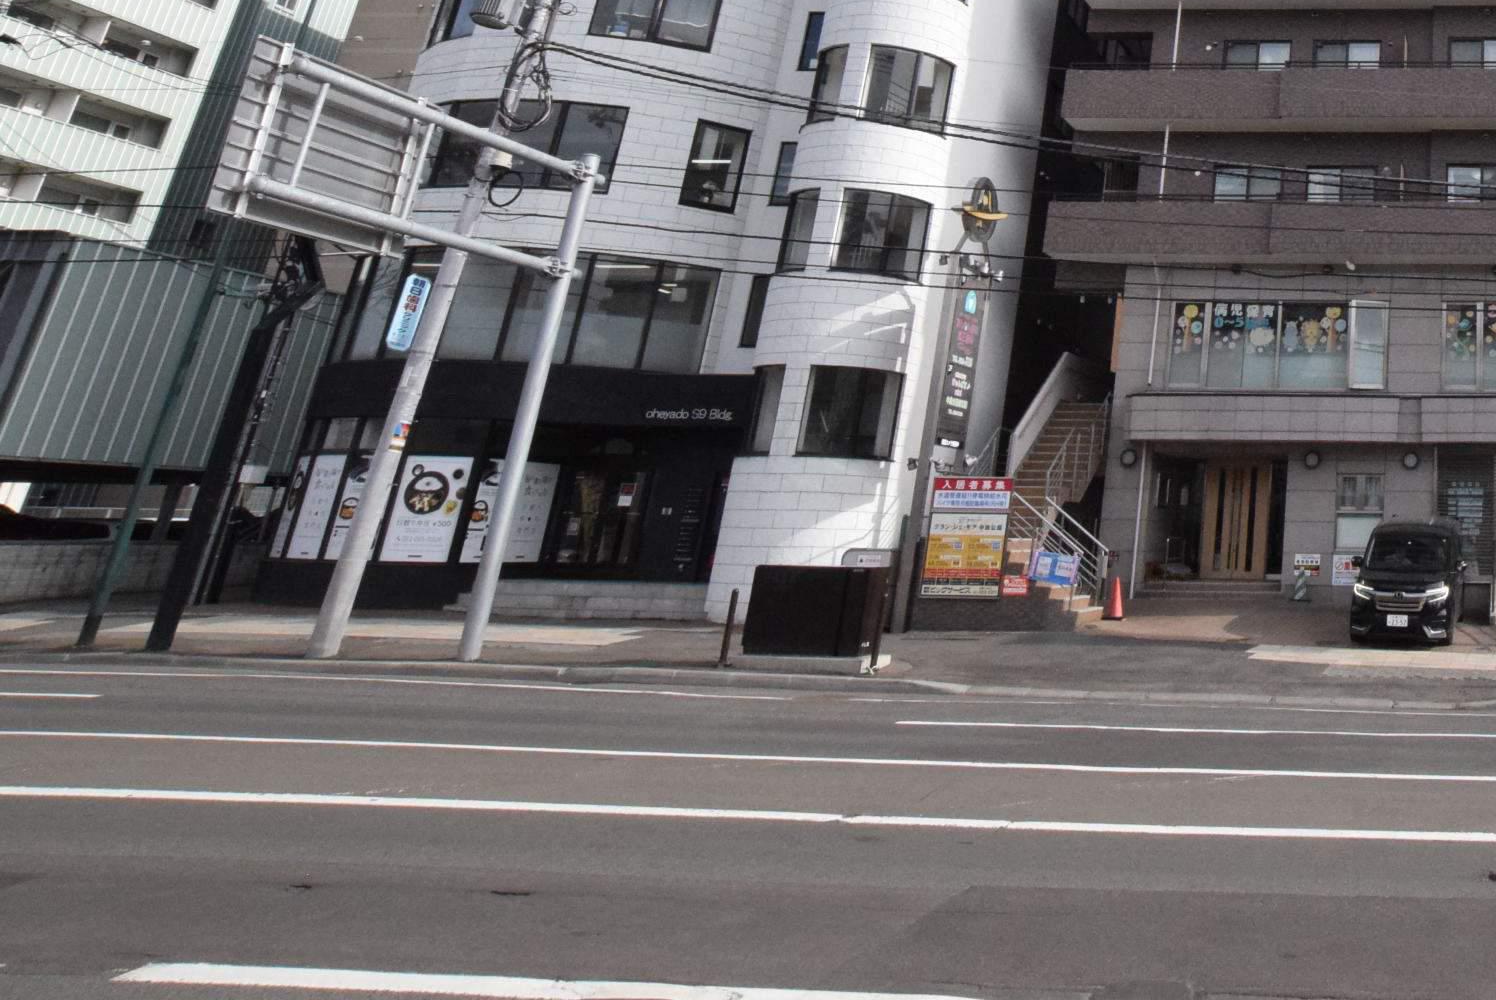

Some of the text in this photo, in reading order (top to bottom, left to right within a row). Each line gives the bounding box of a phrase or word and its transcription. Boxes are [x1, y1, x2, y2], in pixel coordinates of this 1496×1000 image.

[691, 408, 707, 419] S9
[942, 479, 1006, 490] 入居者募集
